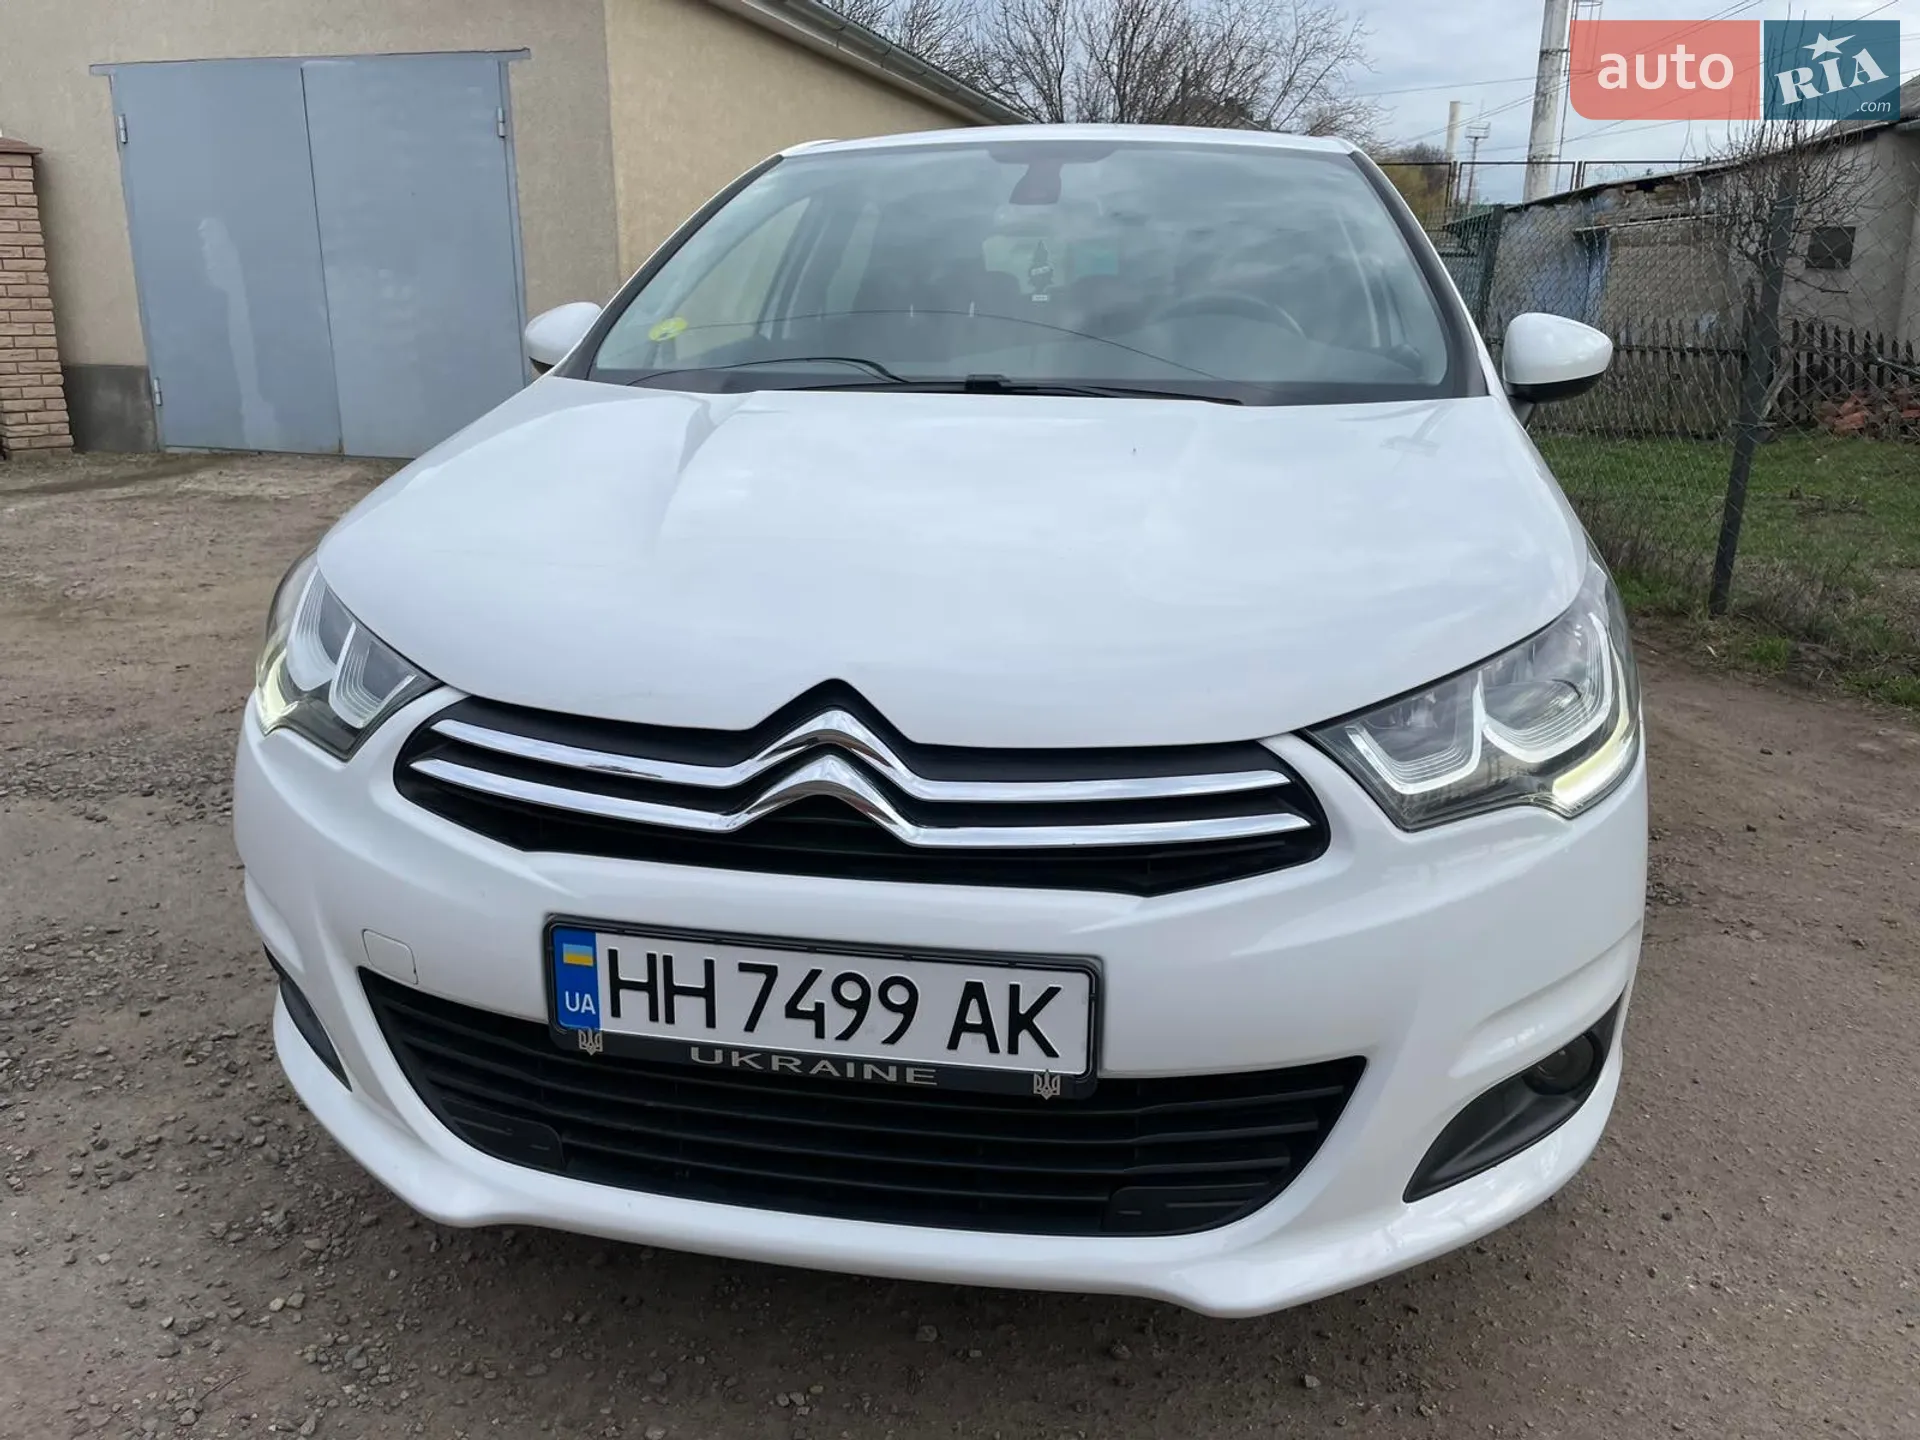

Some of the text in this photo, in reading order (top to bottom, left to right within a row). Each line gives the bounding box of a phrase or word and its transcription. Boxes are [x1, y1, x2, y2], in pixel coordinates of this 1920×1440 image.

[565, 992, 596, 1015] UA
[608, 947, 1062, 1059] HH 7499 AK
[690, 1046, 938, 1086] UKRAINE
